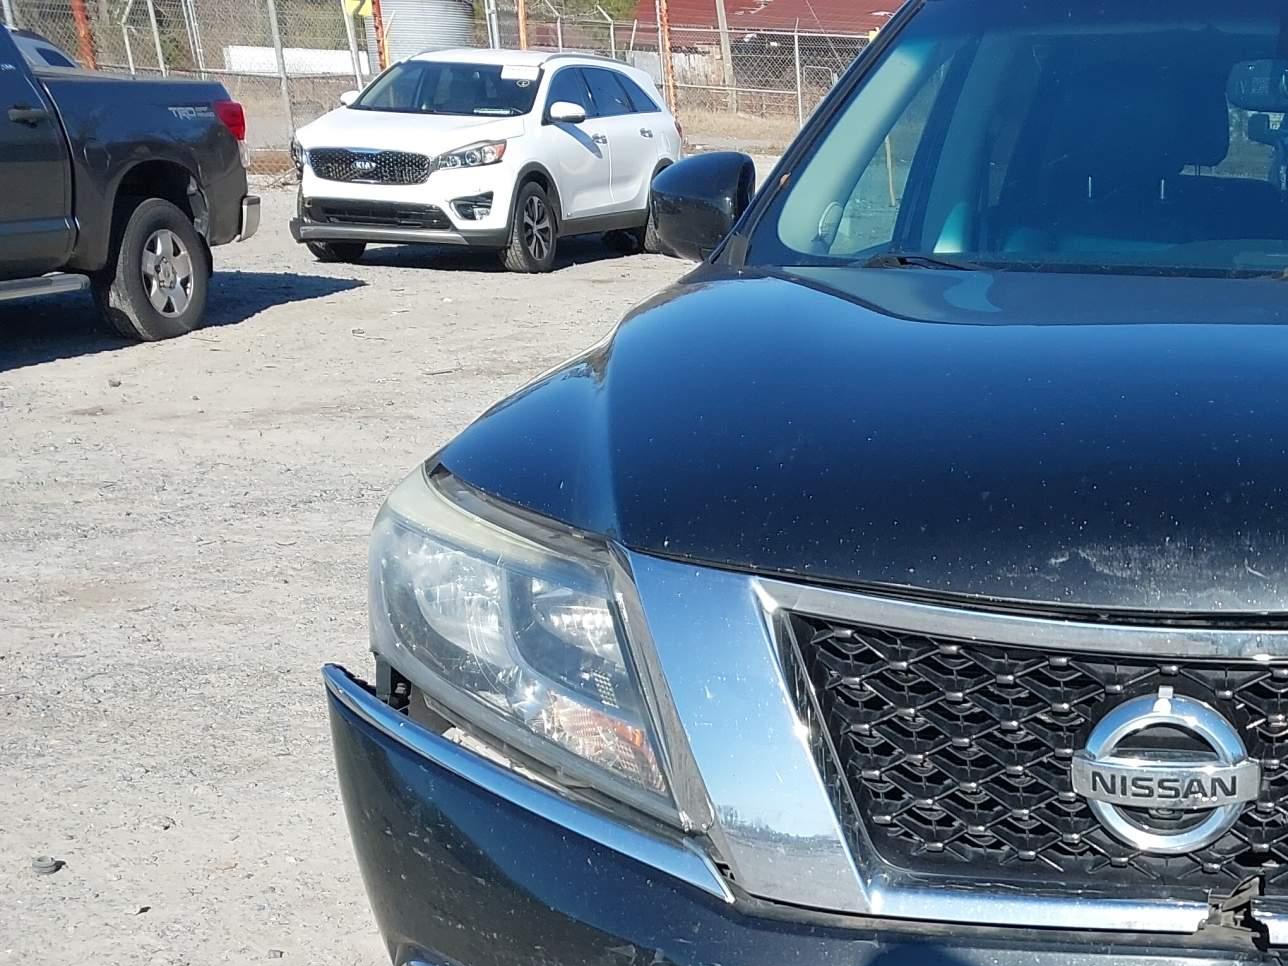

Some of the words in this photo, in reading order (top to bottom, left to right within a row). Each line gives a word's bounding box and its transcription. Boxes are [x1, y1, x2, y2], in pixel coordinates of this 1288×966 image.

[167, 106, 197, 120] TRD
[355, 161, 371, 170] KIA
[1091, 770, 1238, 800] NISSAN
